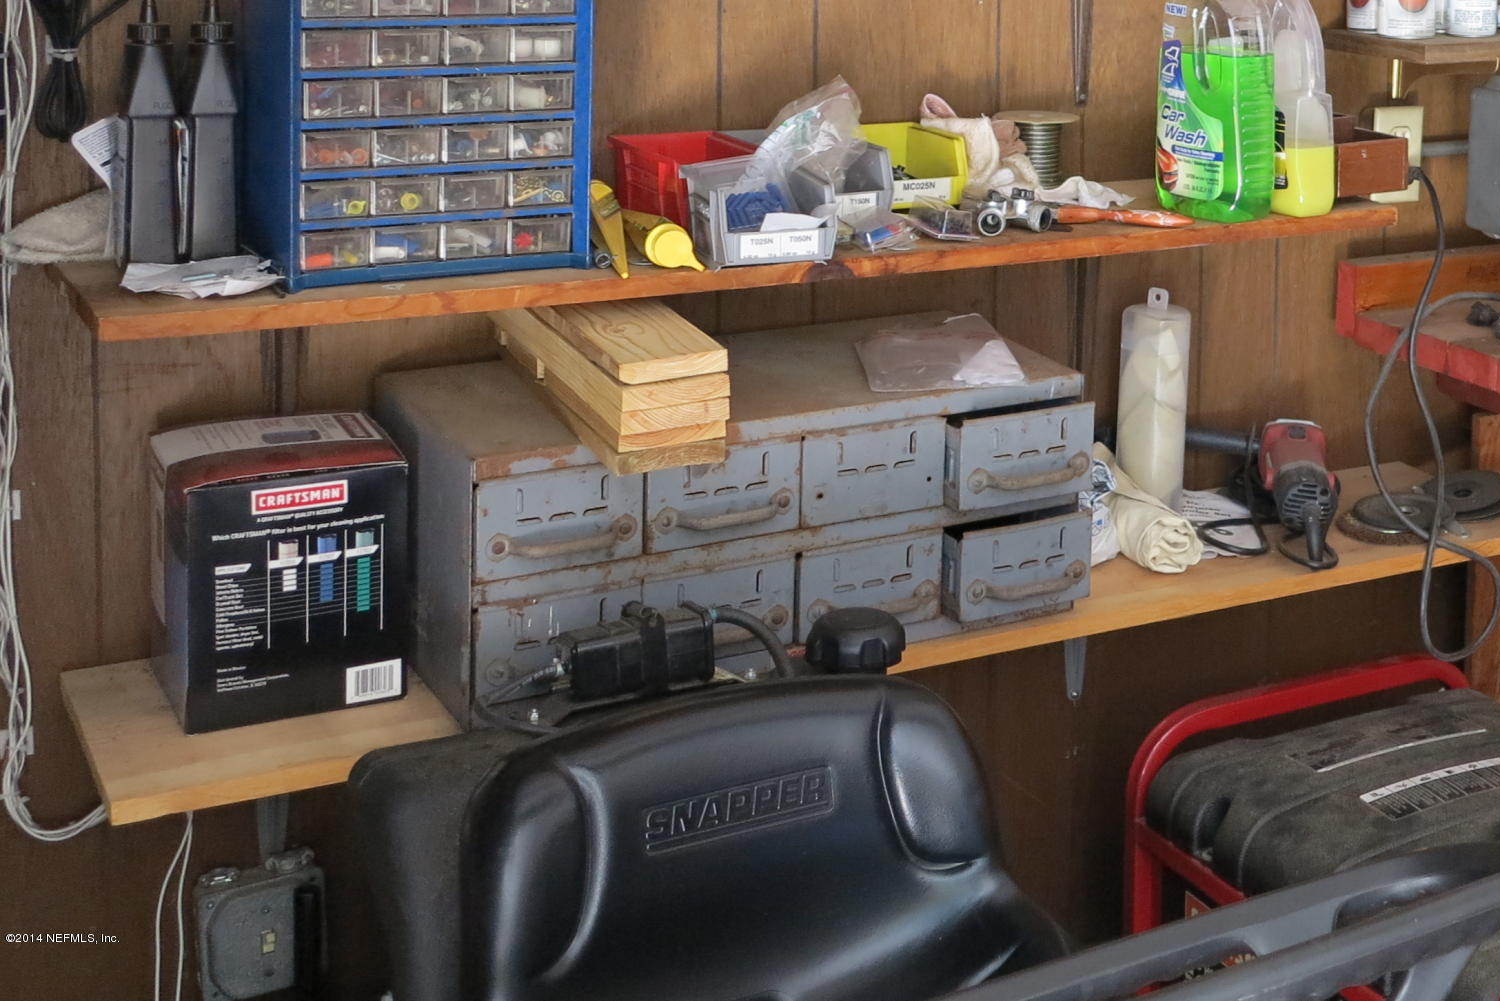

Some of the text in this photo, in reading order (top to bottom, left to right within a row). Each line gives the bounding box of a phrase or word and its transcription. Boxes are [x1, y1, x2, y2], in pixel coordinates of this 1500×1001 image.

[1166, 5, 1187, 15] NEW!
[1161, 104, 1185, 122] Car
[1164, 123, 1206, 146] Wash
[903, 181, 936, 191] MC025N
[750, 237, 774, 245] T025N
[258, 485, 342, 508] CRAFTSMAN
[211, 533, 230, 542] Which
[271, 527, 286, 535] filter
[293, 525, 306, 533] best
[316, 521, 330, 531] your
[330, 517, 354, 528] cleaning
[645, 774, 826, 836] SNAPPER
